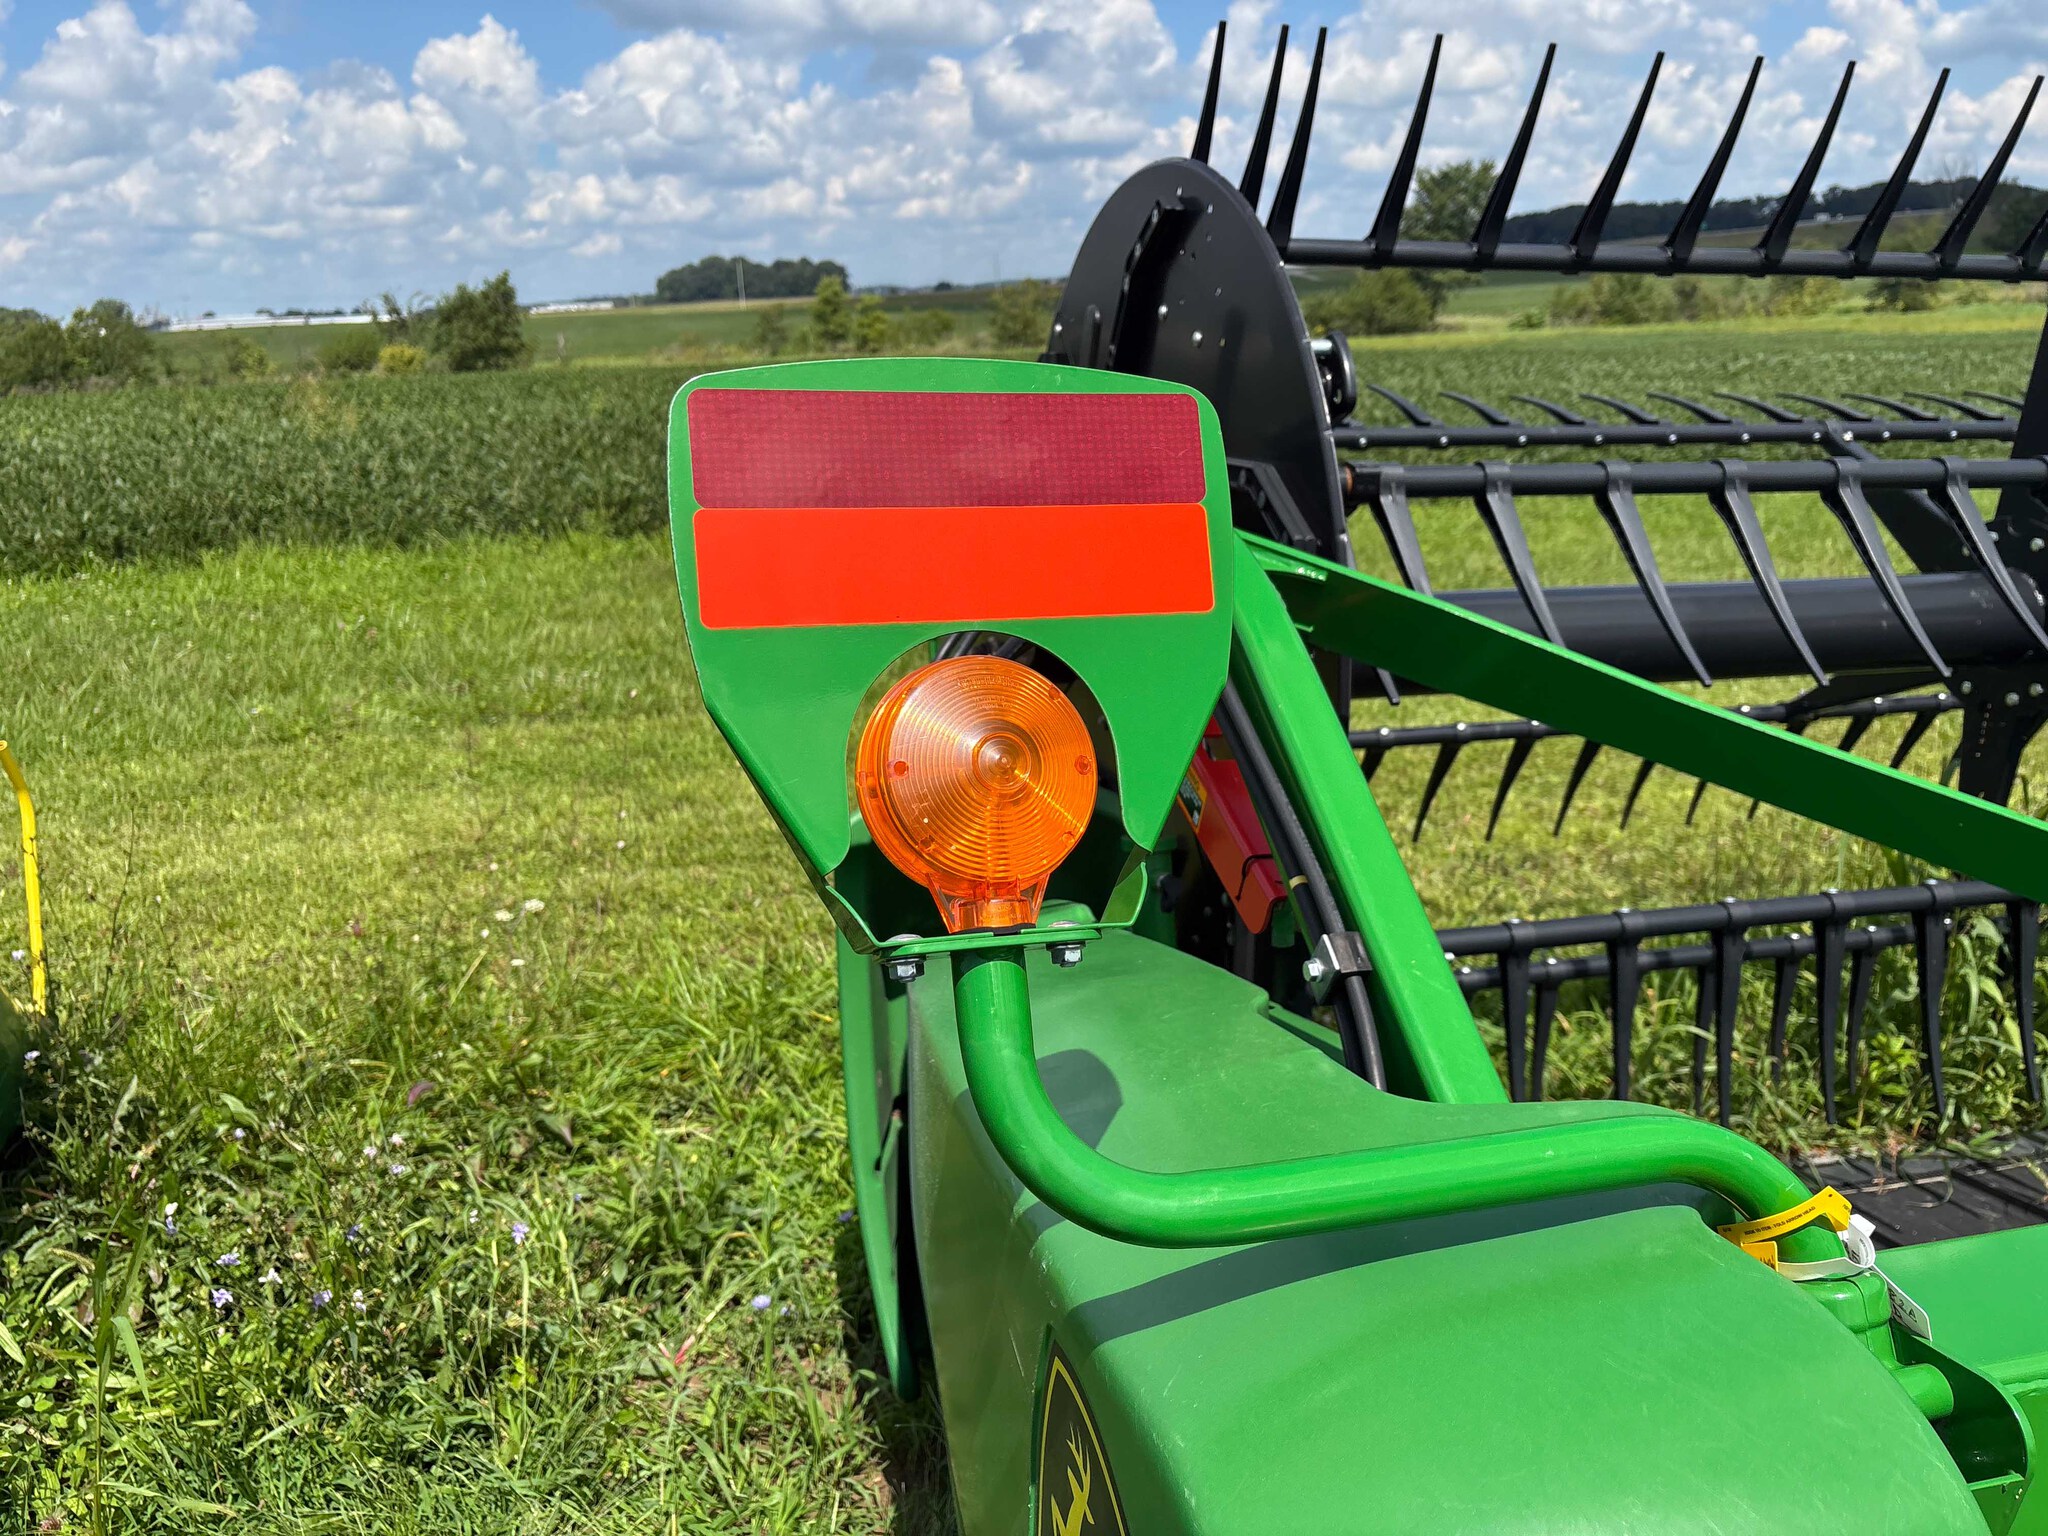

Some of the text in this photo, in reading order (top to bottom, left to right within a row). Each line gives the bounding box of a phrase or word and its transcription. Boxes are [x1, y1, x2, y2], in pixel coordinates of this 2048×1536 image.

[1773, 1220, 1785, 1228] FOLD
[1786, 1213, 1803, 1224] ARROW
[1802, 1206, 1816, 1216] HEAD
